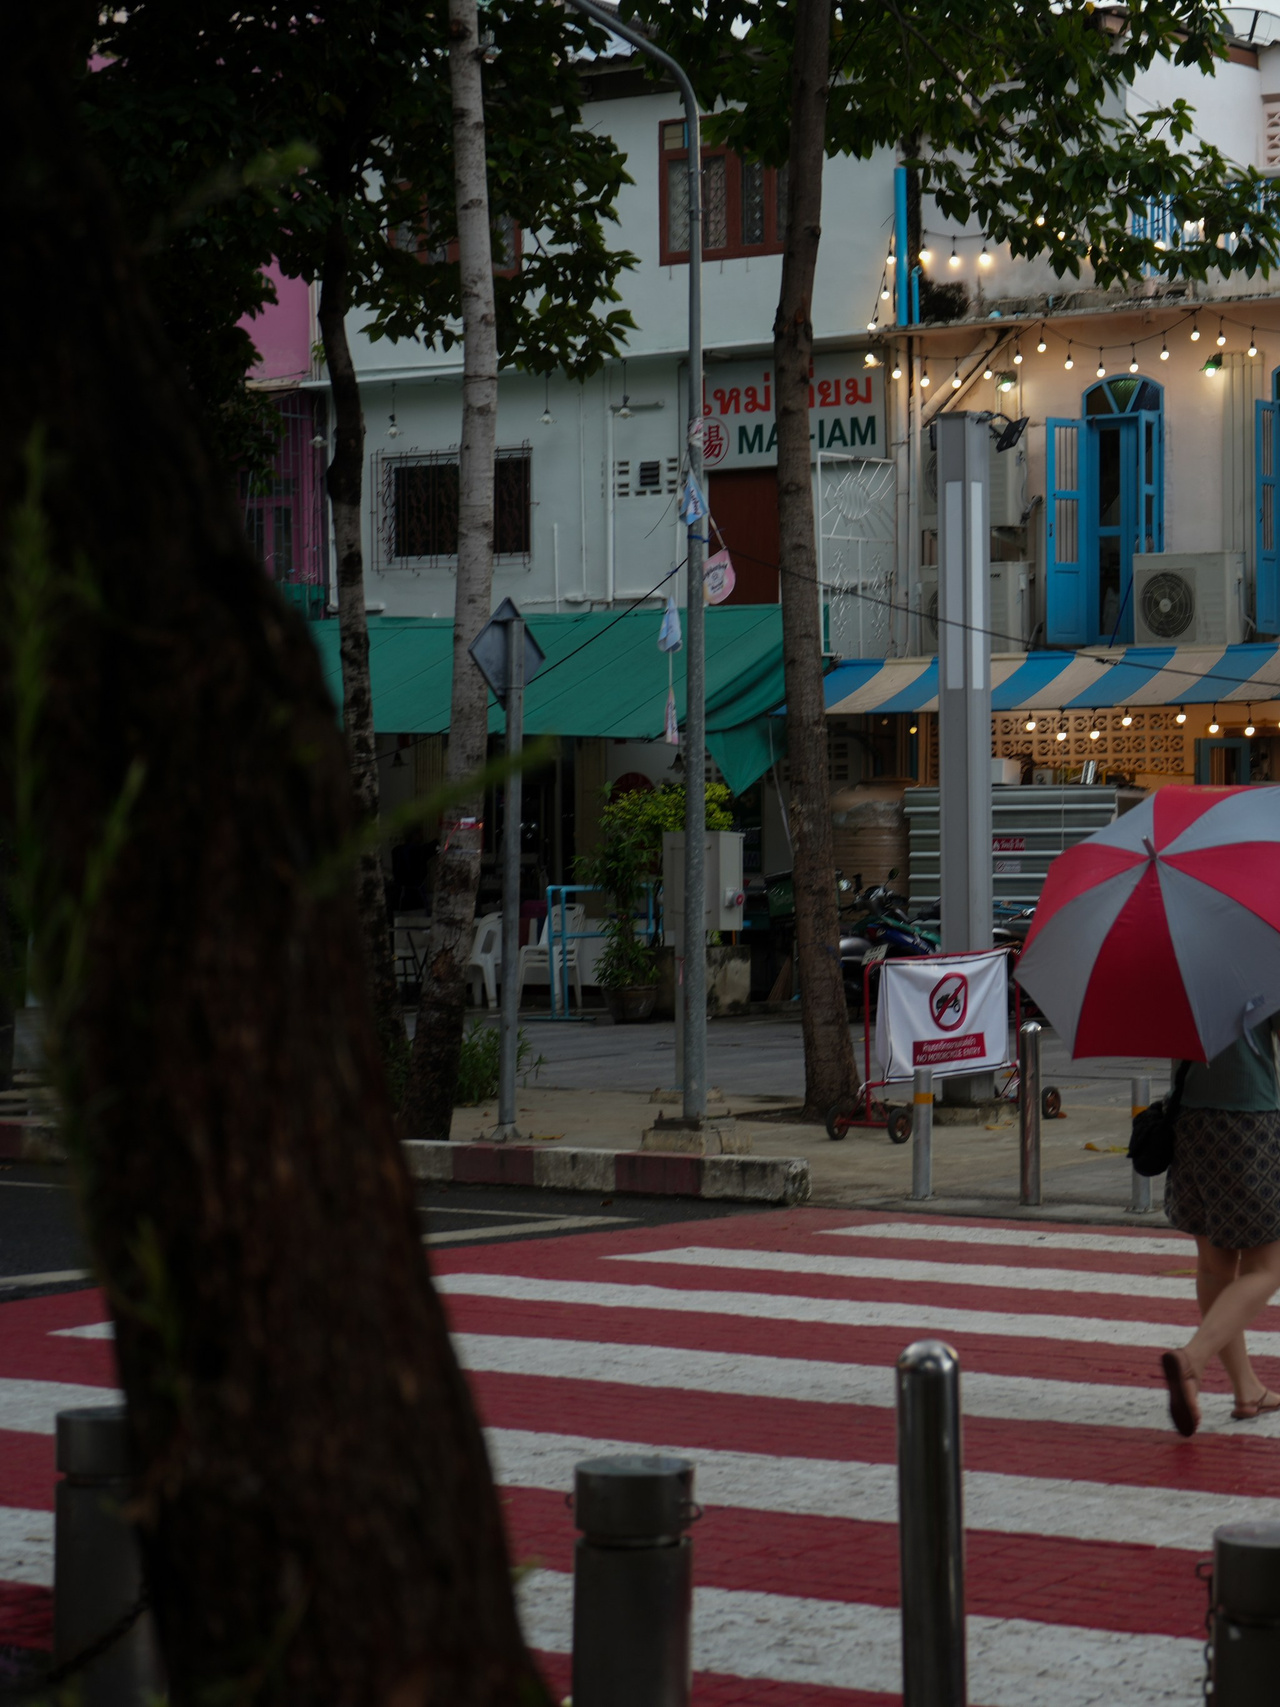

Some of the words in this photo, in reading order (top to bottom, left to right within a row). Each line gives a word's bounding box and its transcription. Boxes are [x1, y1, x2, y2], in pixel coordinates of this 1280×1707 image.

[738, 415, 876, 454] MA-IAM
[915, 1053, 928, 1063] NO
[928, 1048, 962, 1062] MOTORCYCLE
[963, 1046, 981, 1057] ENTRY
